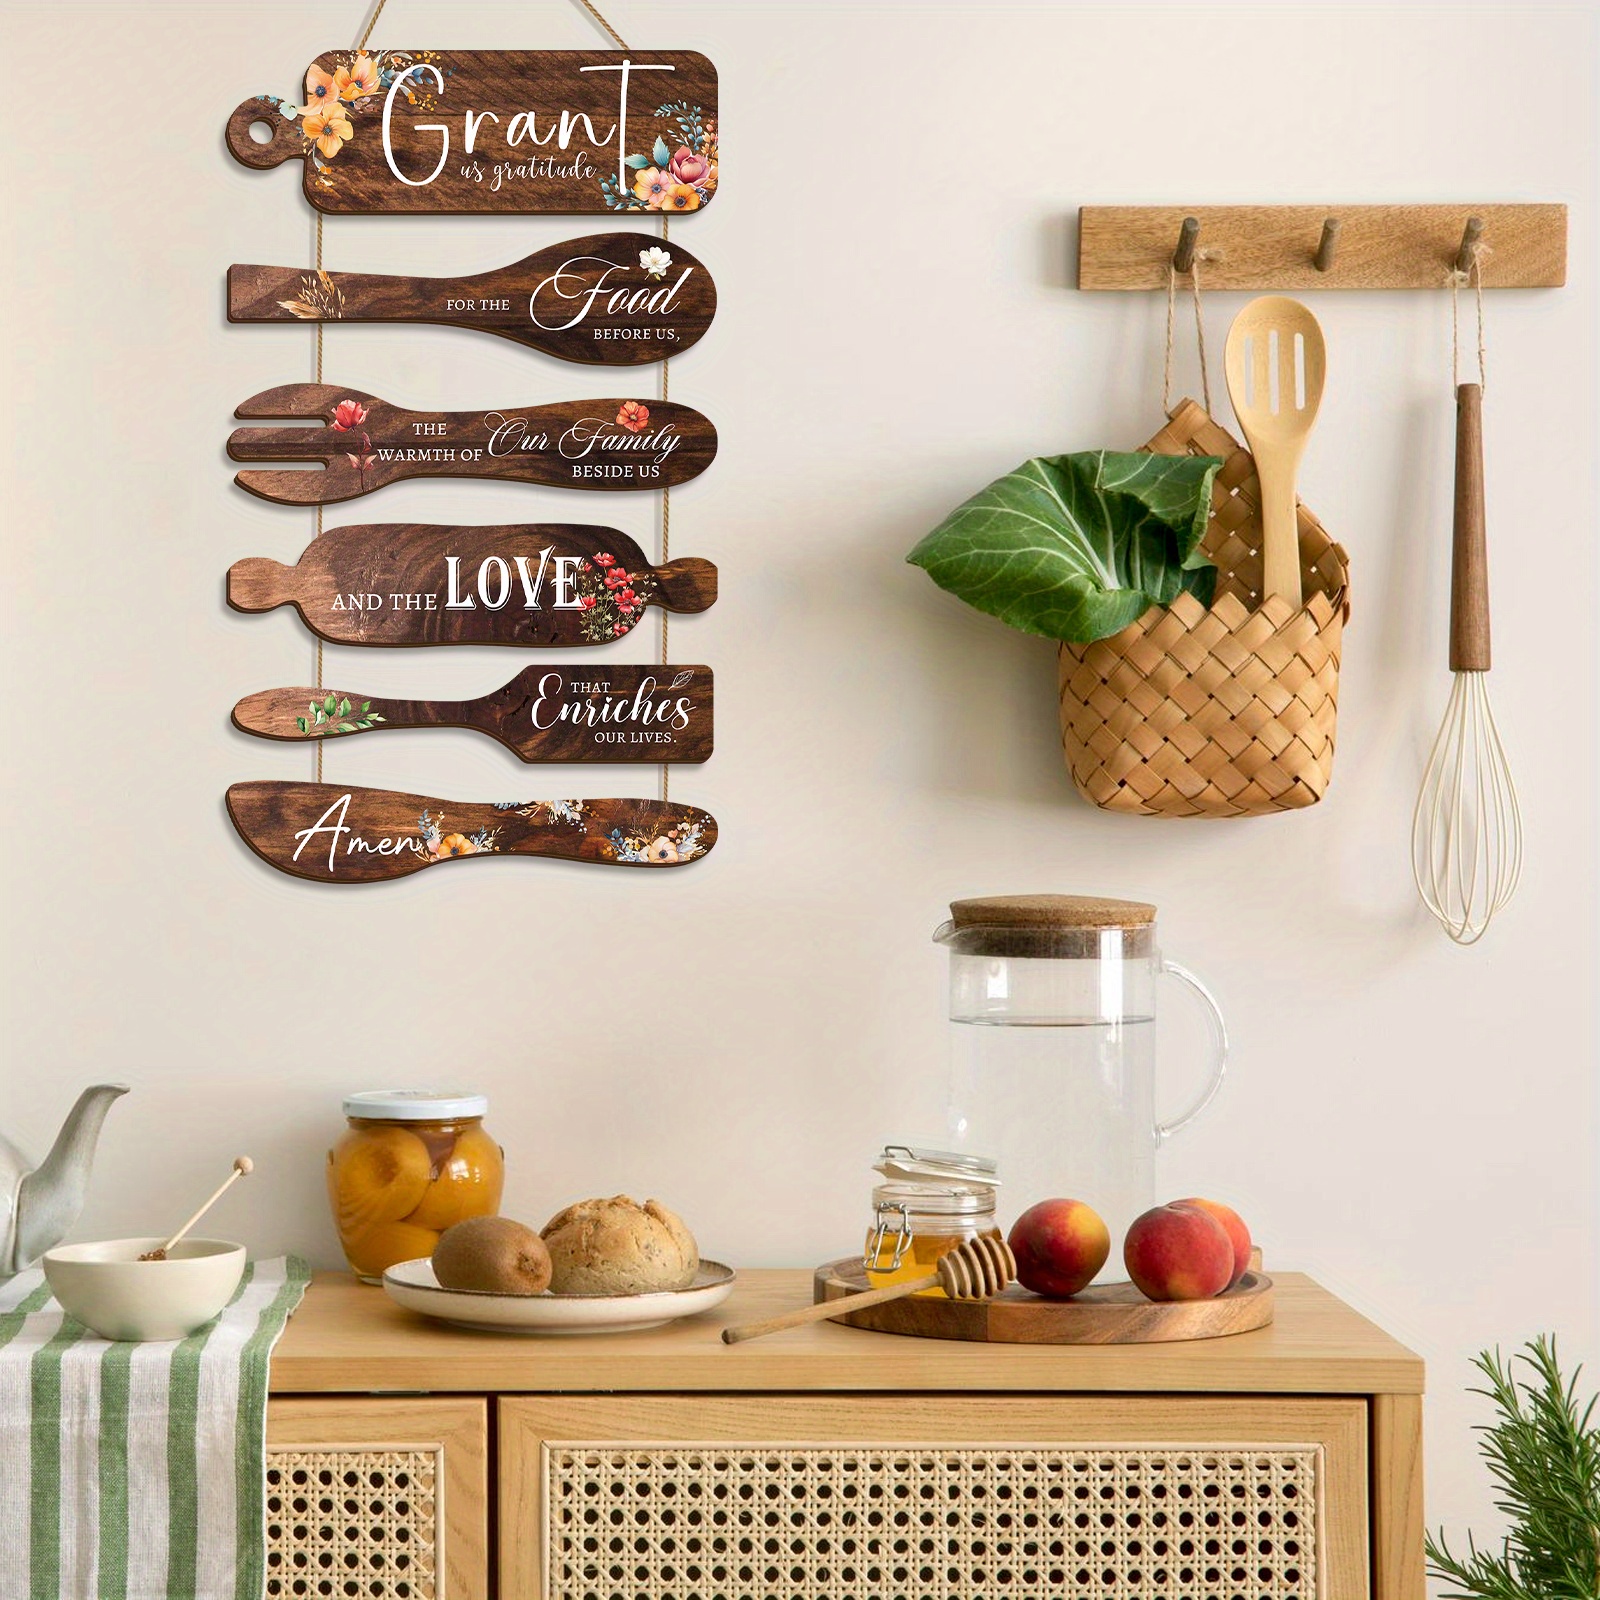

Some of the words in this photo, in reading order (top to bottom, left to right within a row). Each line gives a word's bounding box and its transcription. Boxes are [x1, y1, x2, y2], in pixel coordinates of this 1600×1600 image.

[461, 160, 485, 181] us
[489, 151, 597, 192] gratitude
[446, 299, 477, 311] FOR
[479, 299, 510, 311] THE
[529, 256, 694, 331] Food
[593, 328, 651, 341] BEFORE
[656, 328, 681, 343] US,
[377, 449, 456, 462] WARMTH
[461, 448, 482, 462] OF
[484, 412, 550, 457] Our
[558, 416, 681, 463] Family
[412, 422, 447, 436] THE
[572, 465, 633, 478] BESIDE
[638, 465, 660, 478] US
[330, 593, 382, 611] AND
[388, 592, 437, 611] THE
[444, 545, 587, 611] LOVE
[531, 672, 697, 730] Enriches
[570, 681, 610, 694] THAT
[594, 731, 626, 744] OUR
[630, 731, 678, 744] LIVES.
[293, 794, 423, 872] Amen
